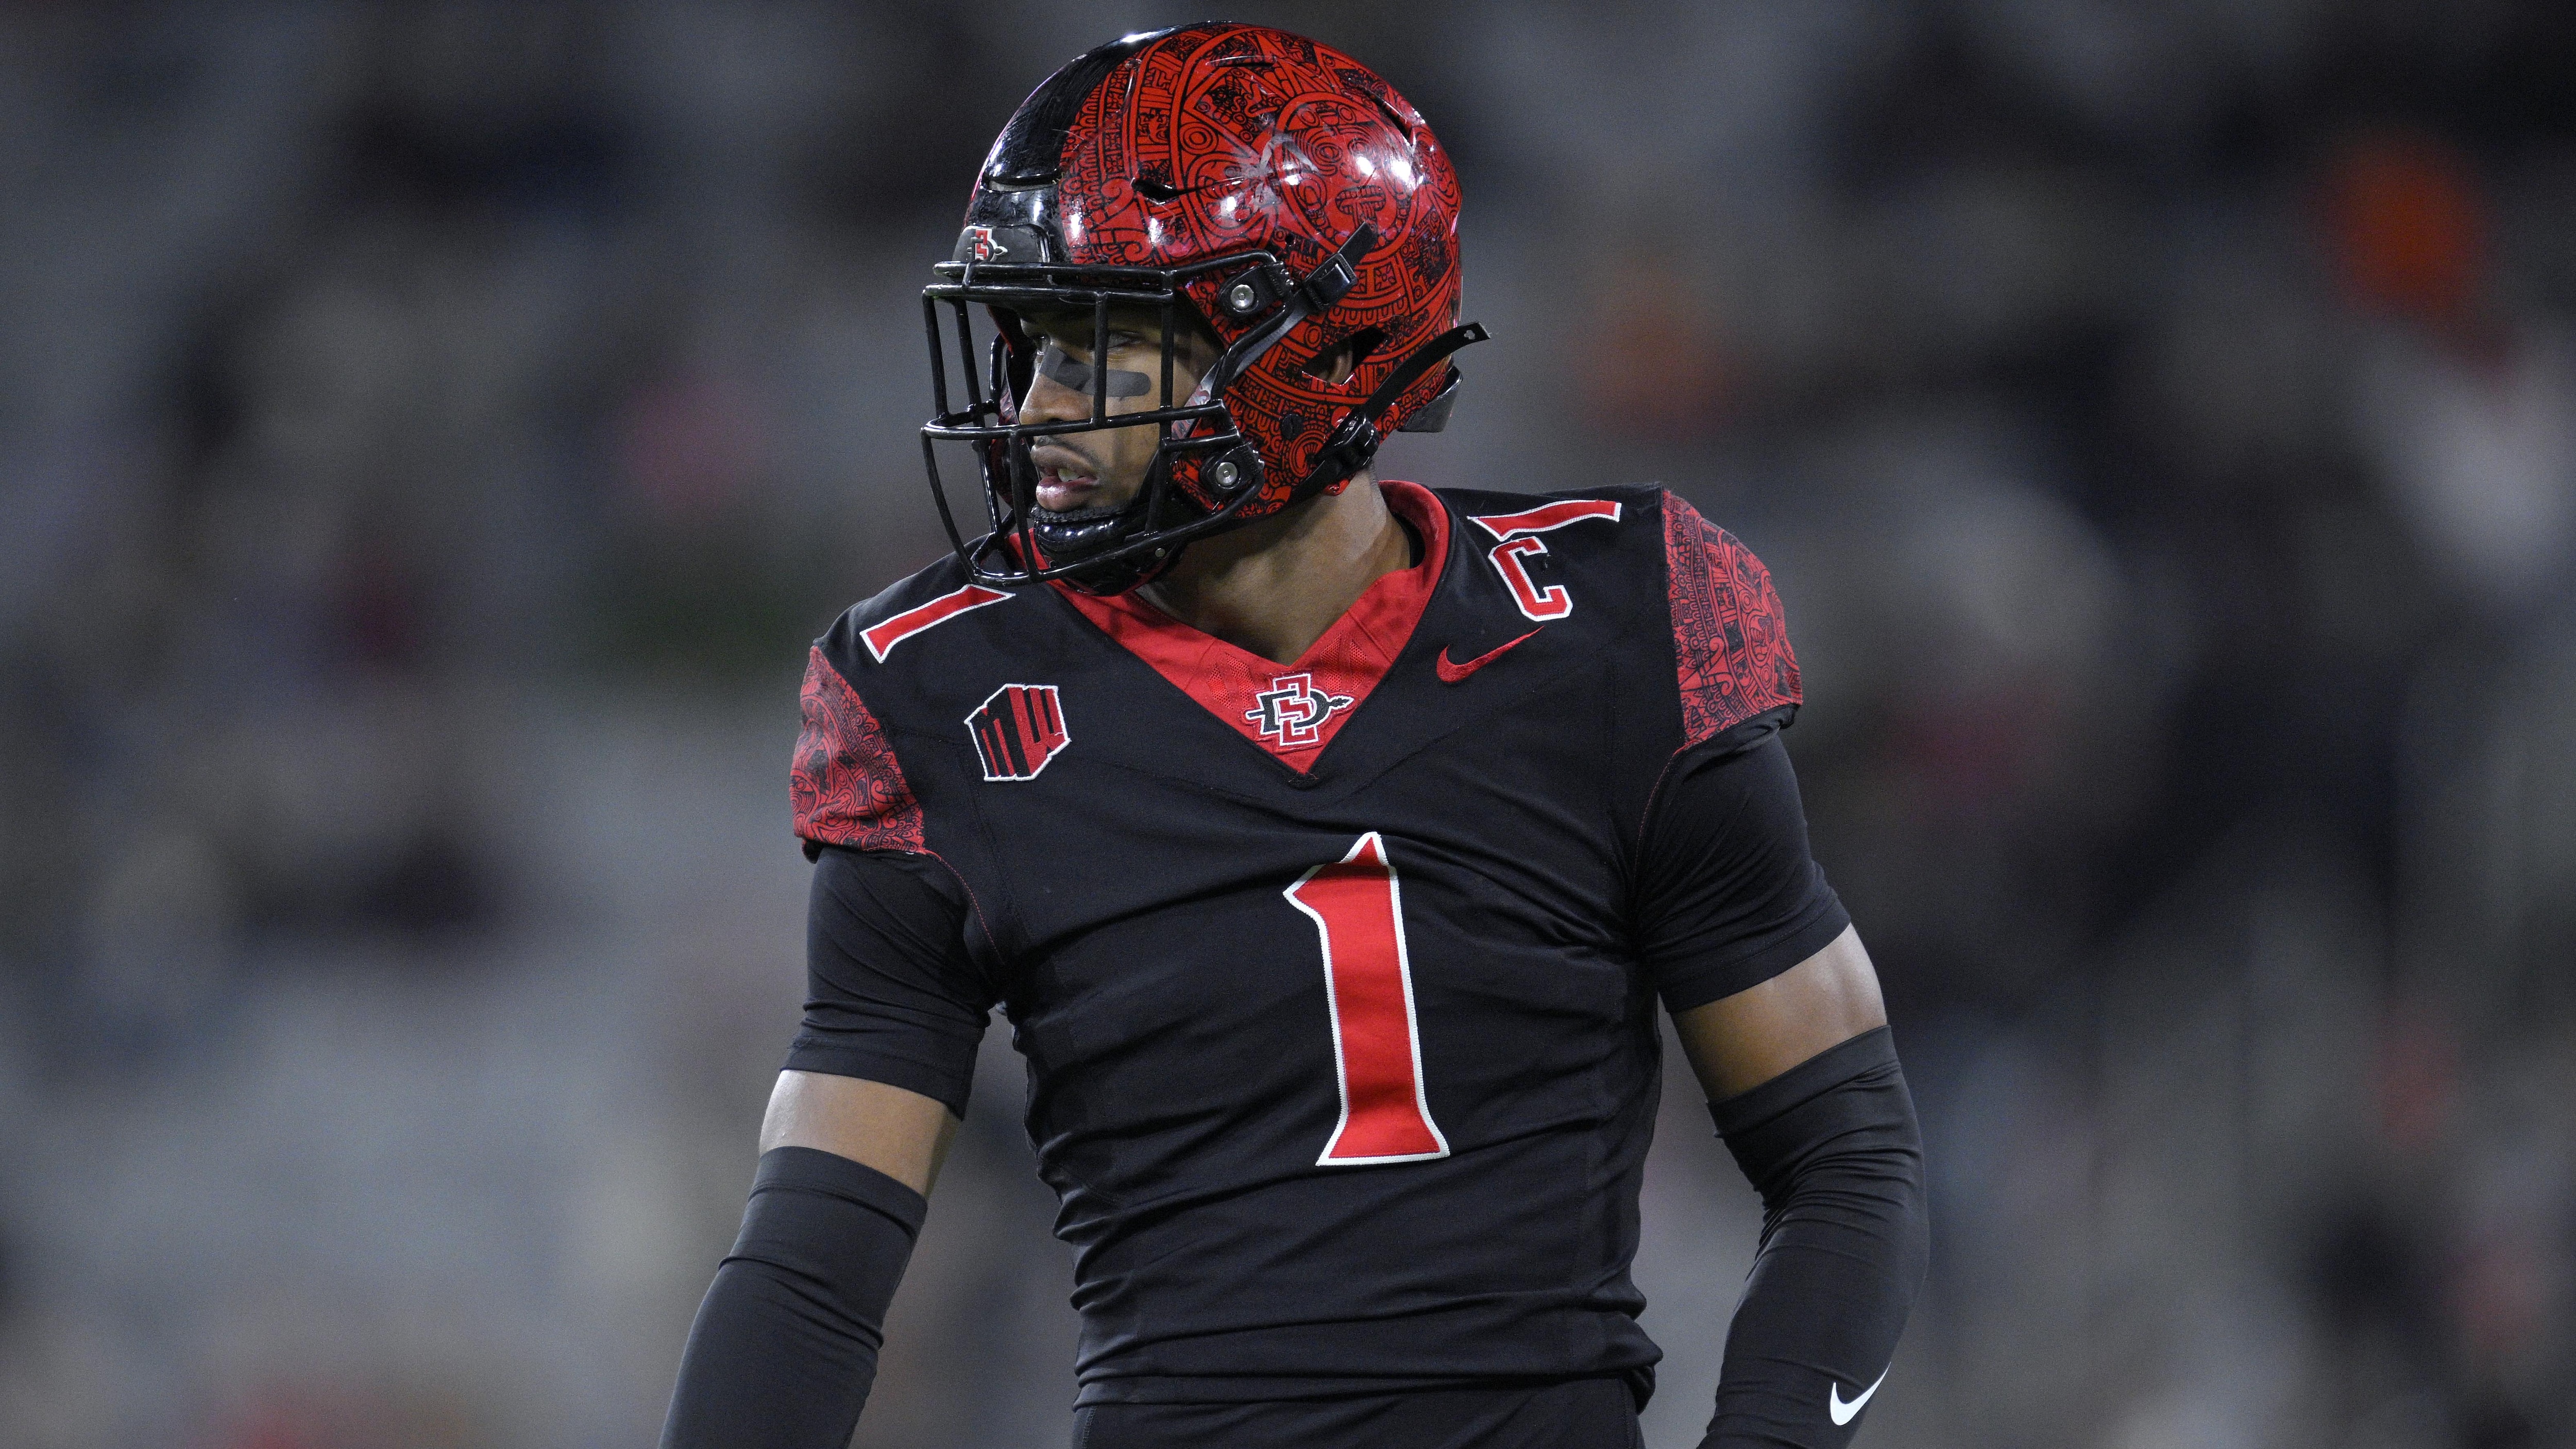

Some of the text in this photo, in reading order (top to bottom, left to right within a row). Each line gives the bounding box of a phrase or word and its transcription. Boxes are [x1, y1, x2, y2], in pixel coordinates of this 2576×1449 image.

[1488, 536, 1573, 622] C
[859, 584, 1016, 664] 1
[1283, 831, 1450, 1166] 1
